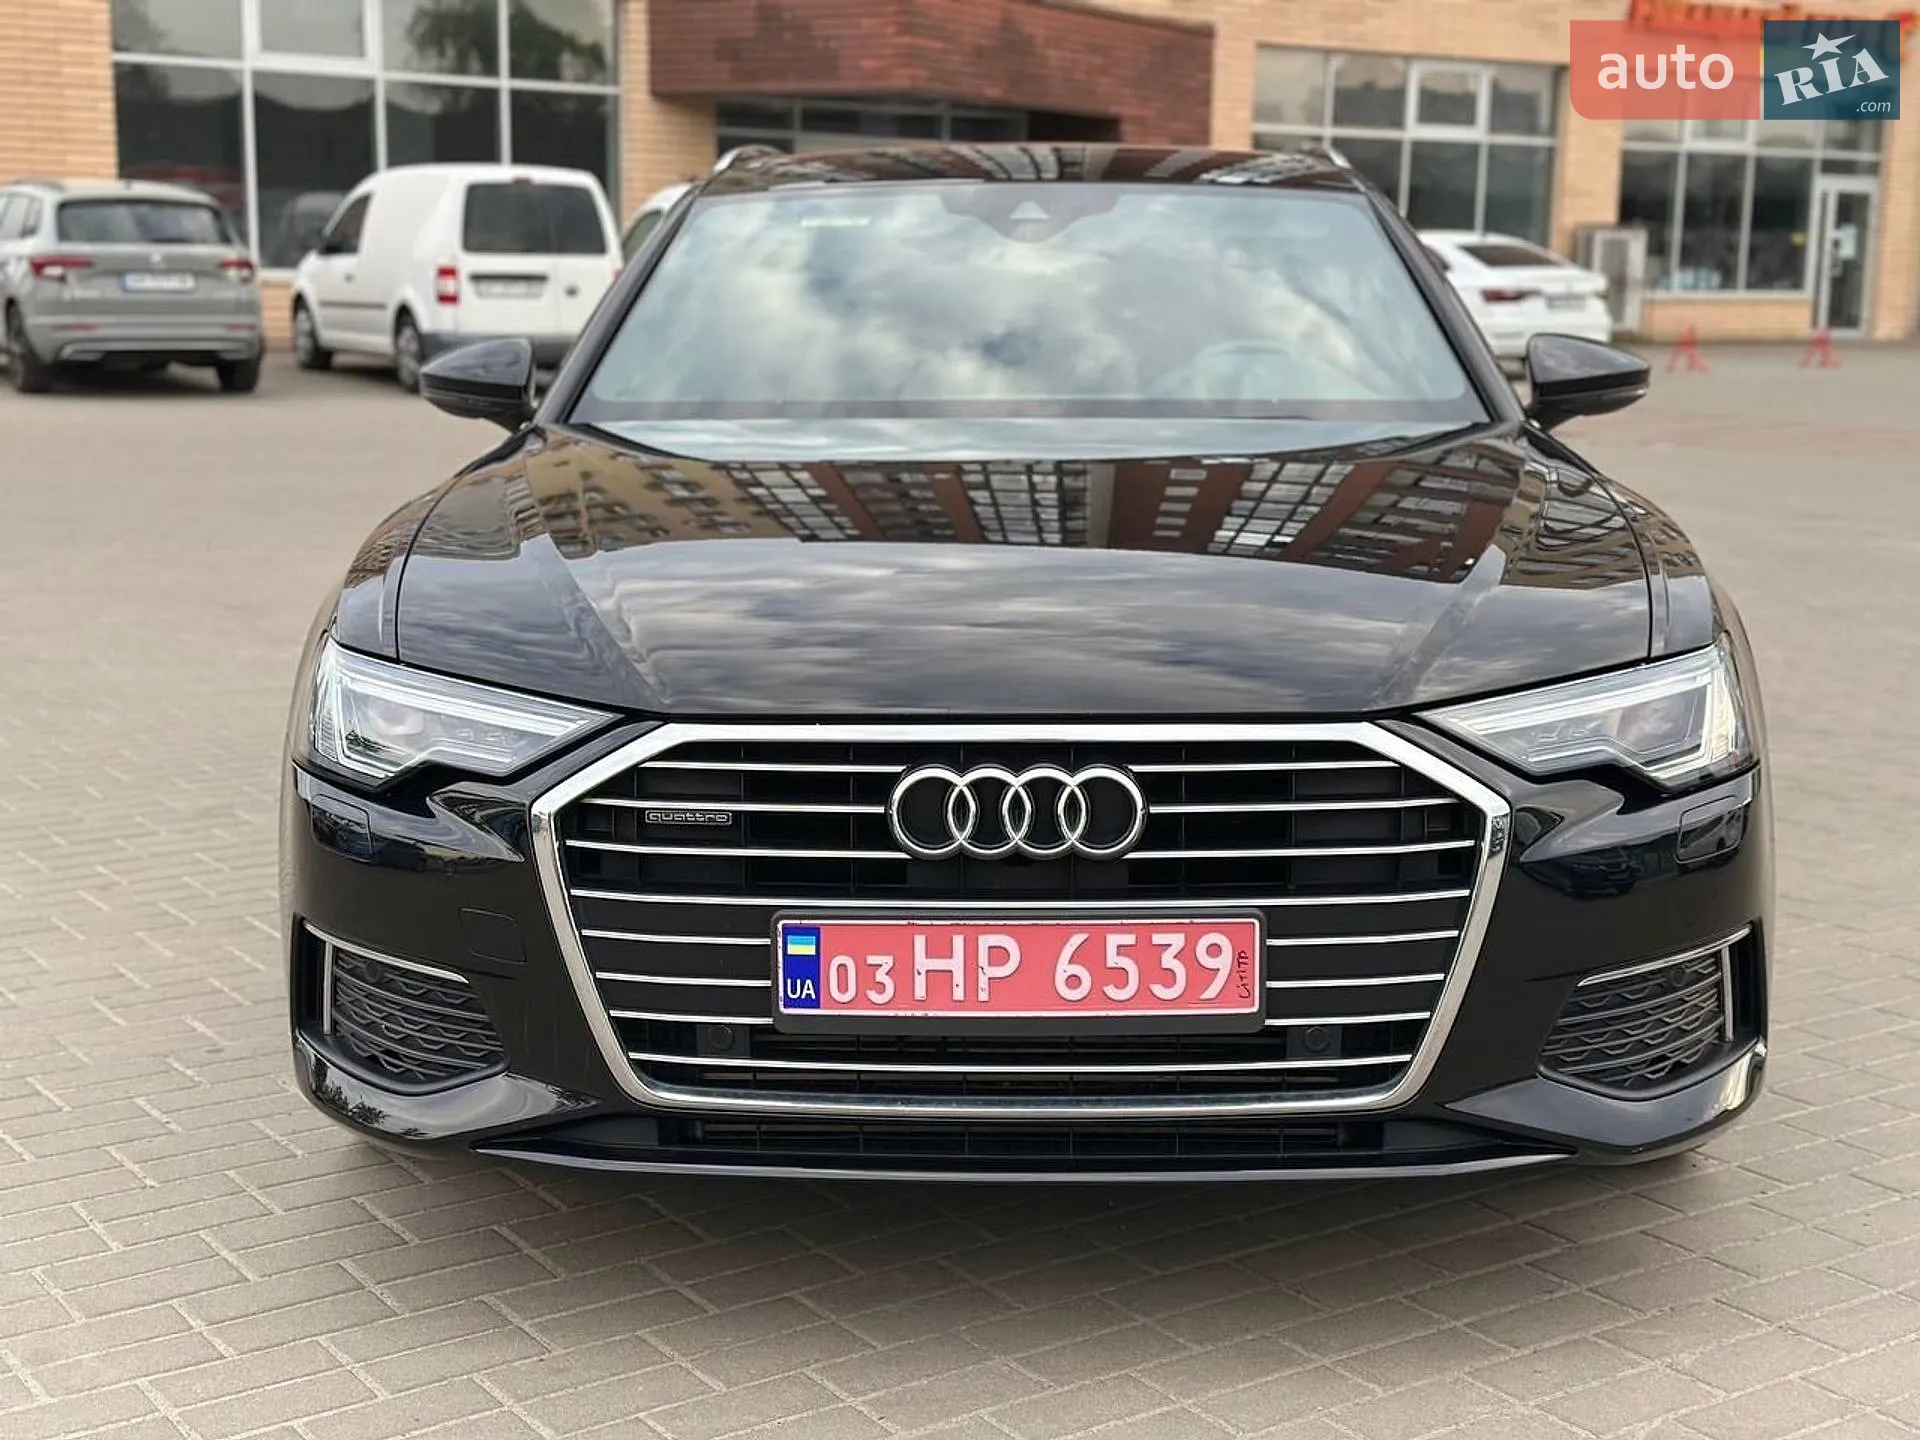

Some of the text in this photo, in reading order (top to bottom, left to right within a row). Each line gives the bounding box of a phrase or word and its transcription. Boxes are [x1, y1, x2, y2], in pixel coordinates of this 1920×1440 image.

[648, 812, 728, 823] quattro
[828, 932, 1235, 1005] 03 HP 6539
[787, 978, 816, 1000] UA
